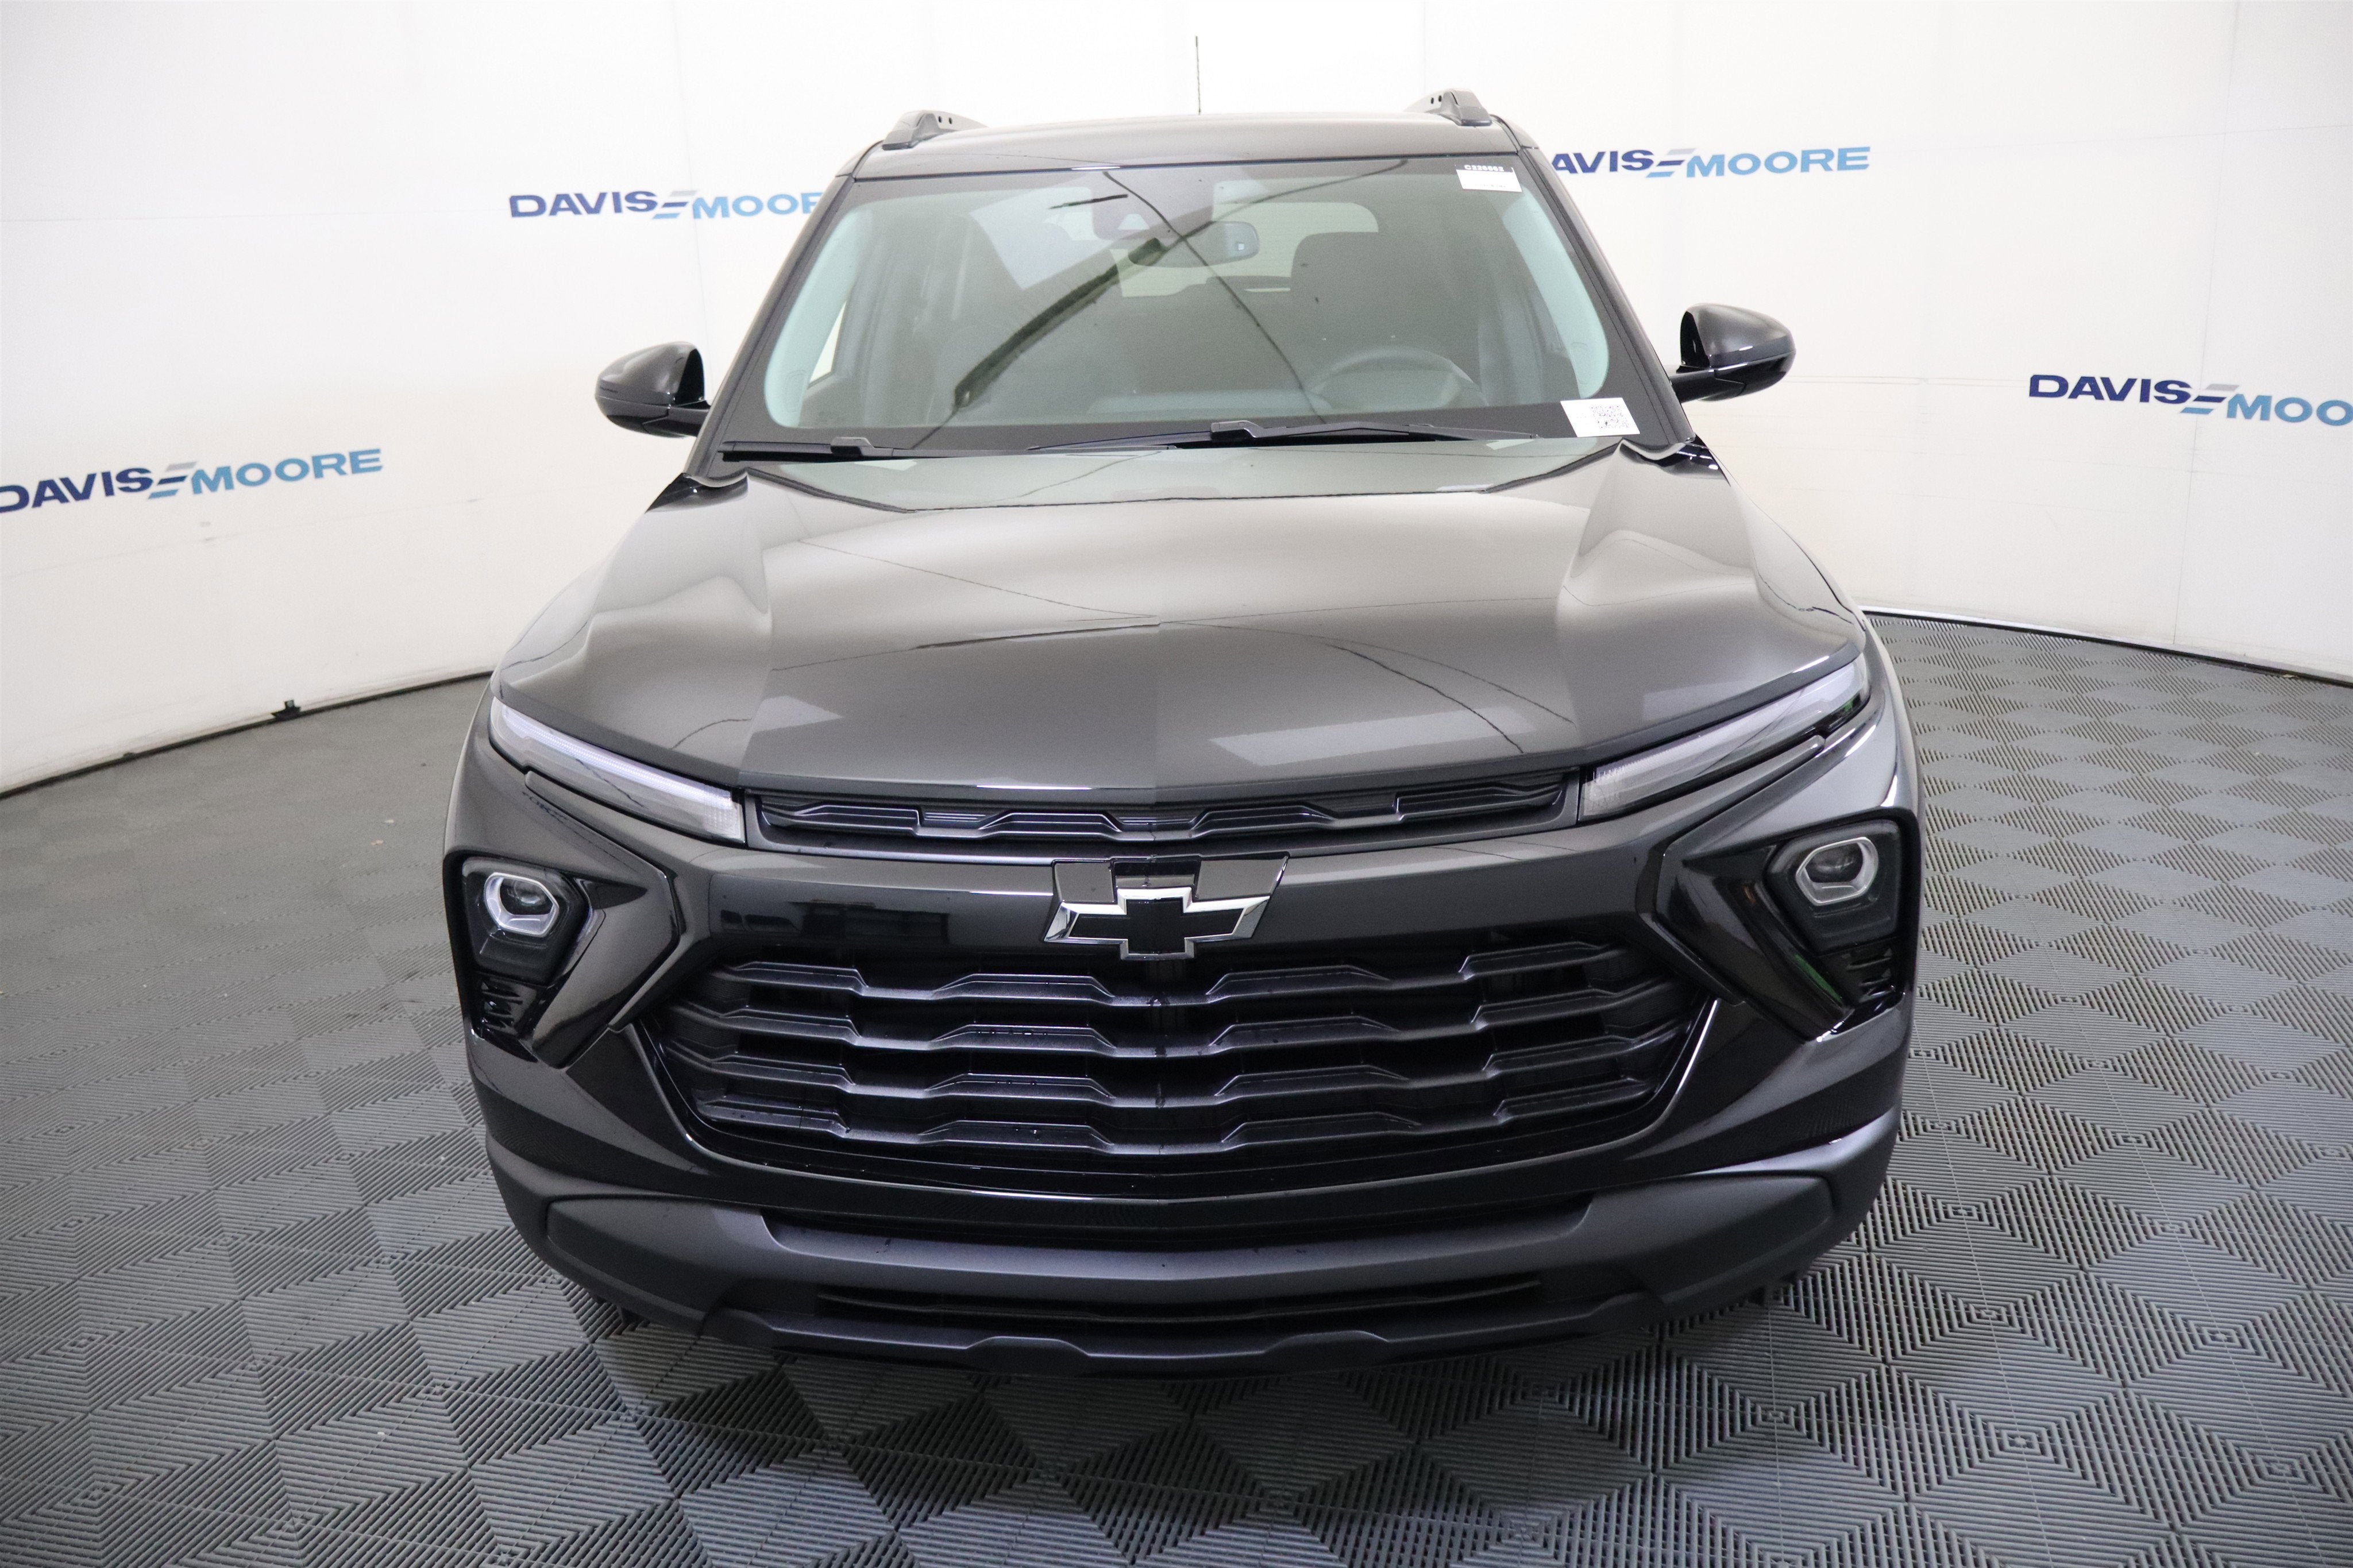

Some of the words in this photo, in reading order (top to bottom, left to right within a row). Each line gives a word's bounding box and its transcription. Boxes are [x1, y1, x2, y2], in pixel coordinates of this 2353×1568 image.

[1552, 150, 1654, 174] AVIS
[1687, 146, 1870, 178] MOORE
[510, 191, 657, 218] DAVIS
[2030, 374, 2192, 404] DAVIS
[2227, 394, 2353, 426] MOO
[0, 468, 153, 513] DAVIS
[191, 449, 383, 495] MOORE
